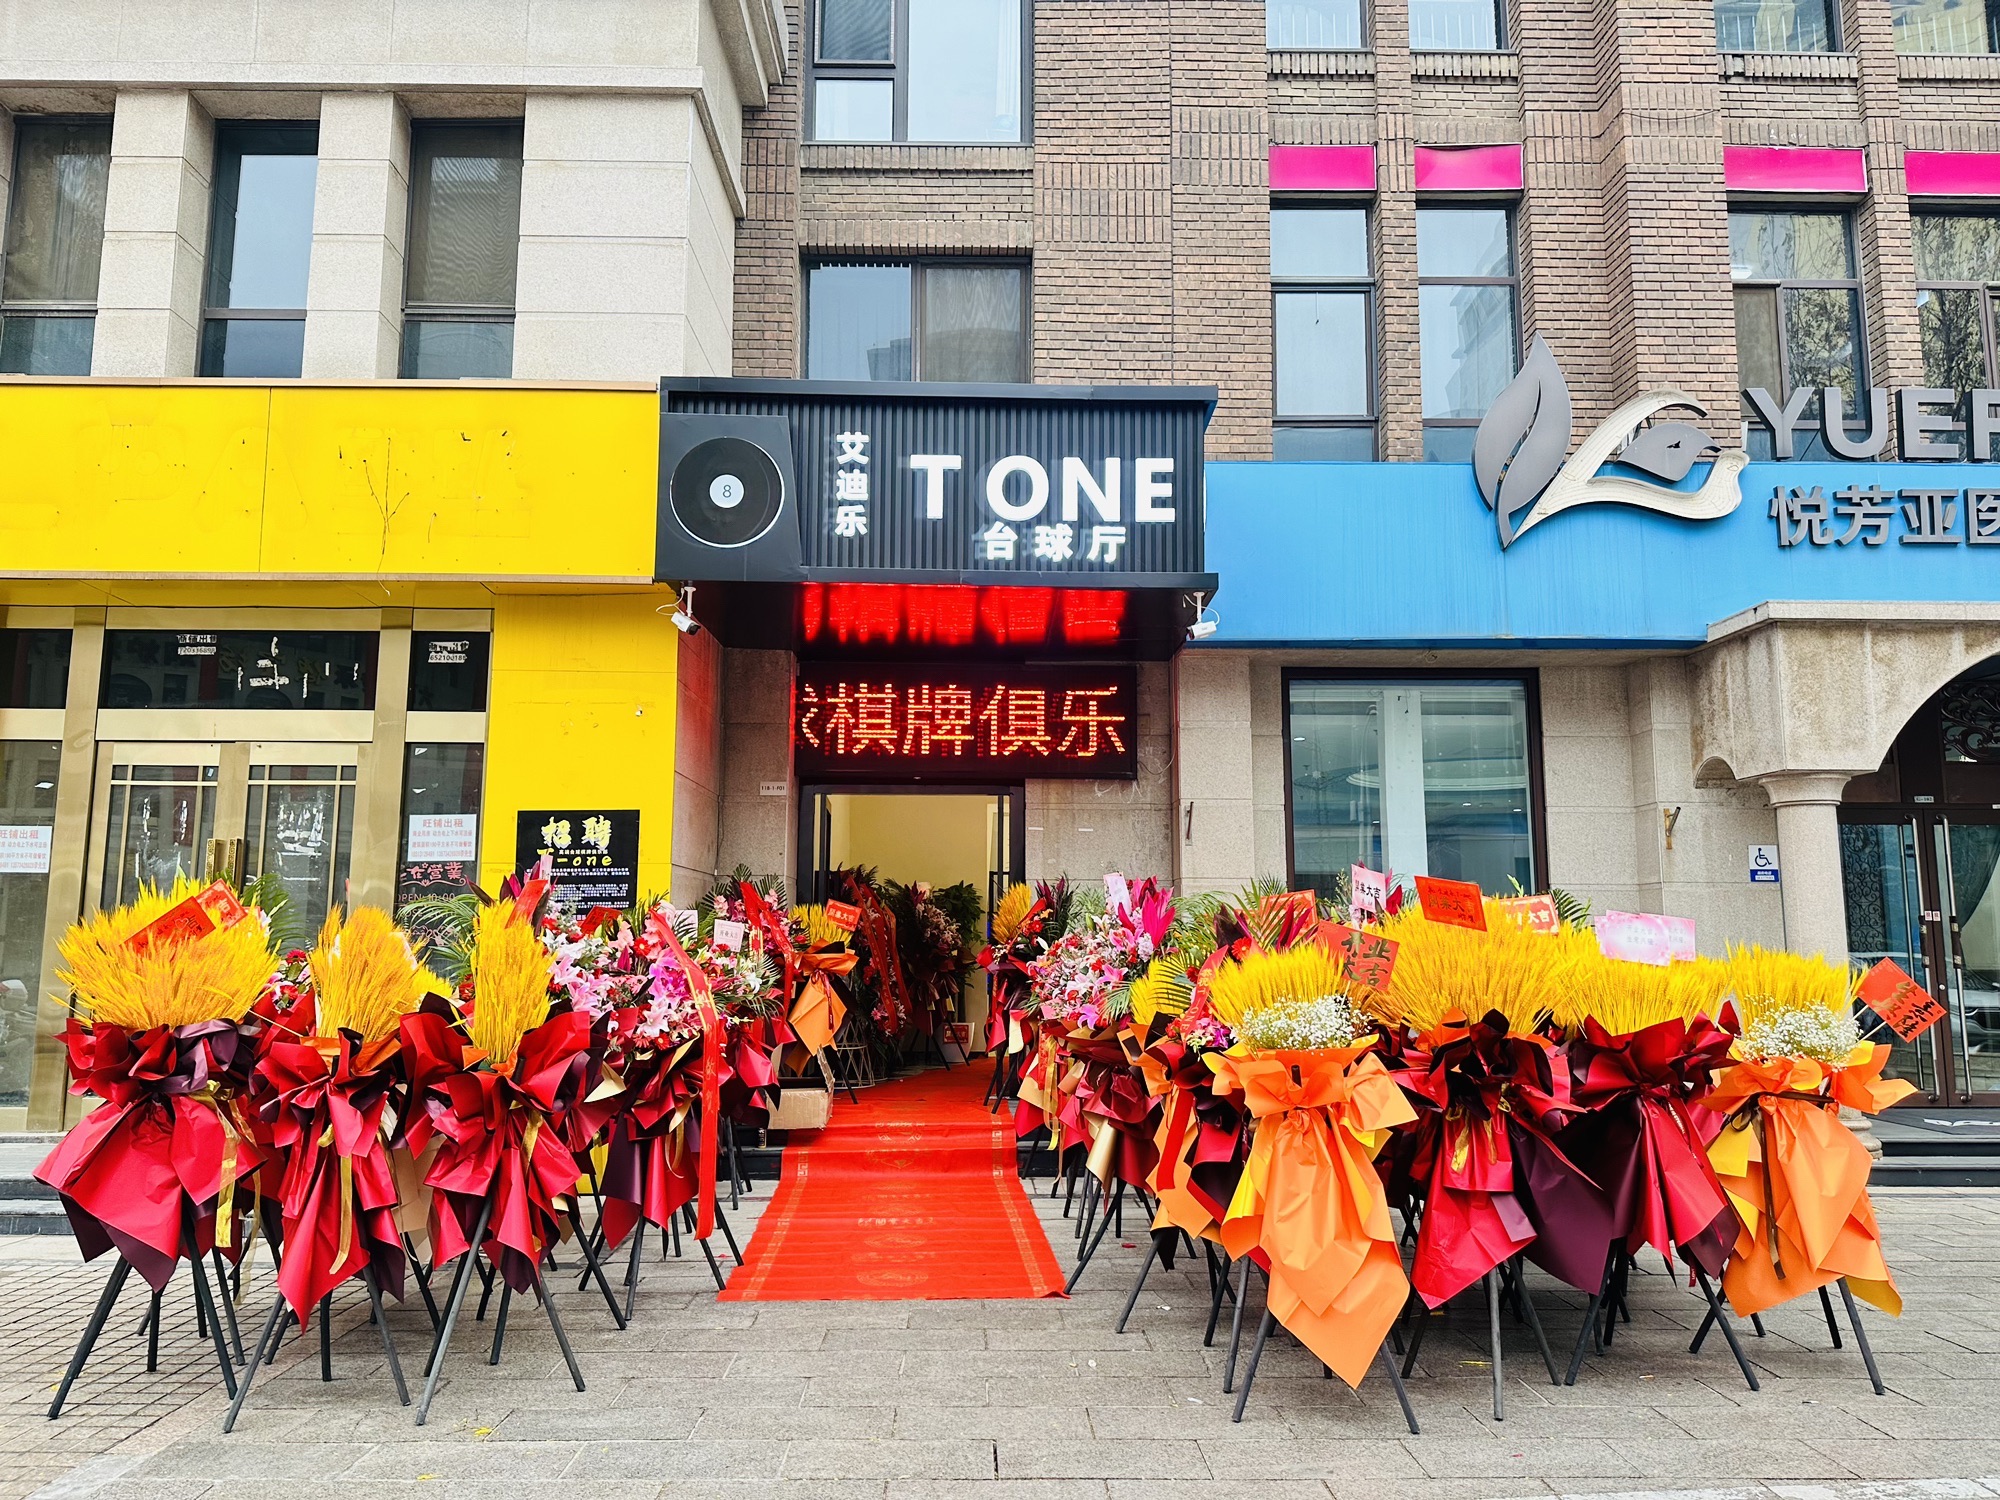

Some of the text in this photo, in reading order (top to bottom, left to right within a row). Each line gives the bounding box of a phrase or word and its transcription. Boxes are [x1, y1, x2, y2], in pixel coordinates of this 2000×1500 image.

[723, 484, 732, 498] 8
[835, 431, 869, 538] 艾迪乐
[983, 522, 1127, 563] 台球厅
[422, 818, 463, 828] 旺铺出租
[540, 814, 612, 851] 招聘
[1341, 931, 1391, 962] 开业
[1341, 955, 1389, 986] 大吉
